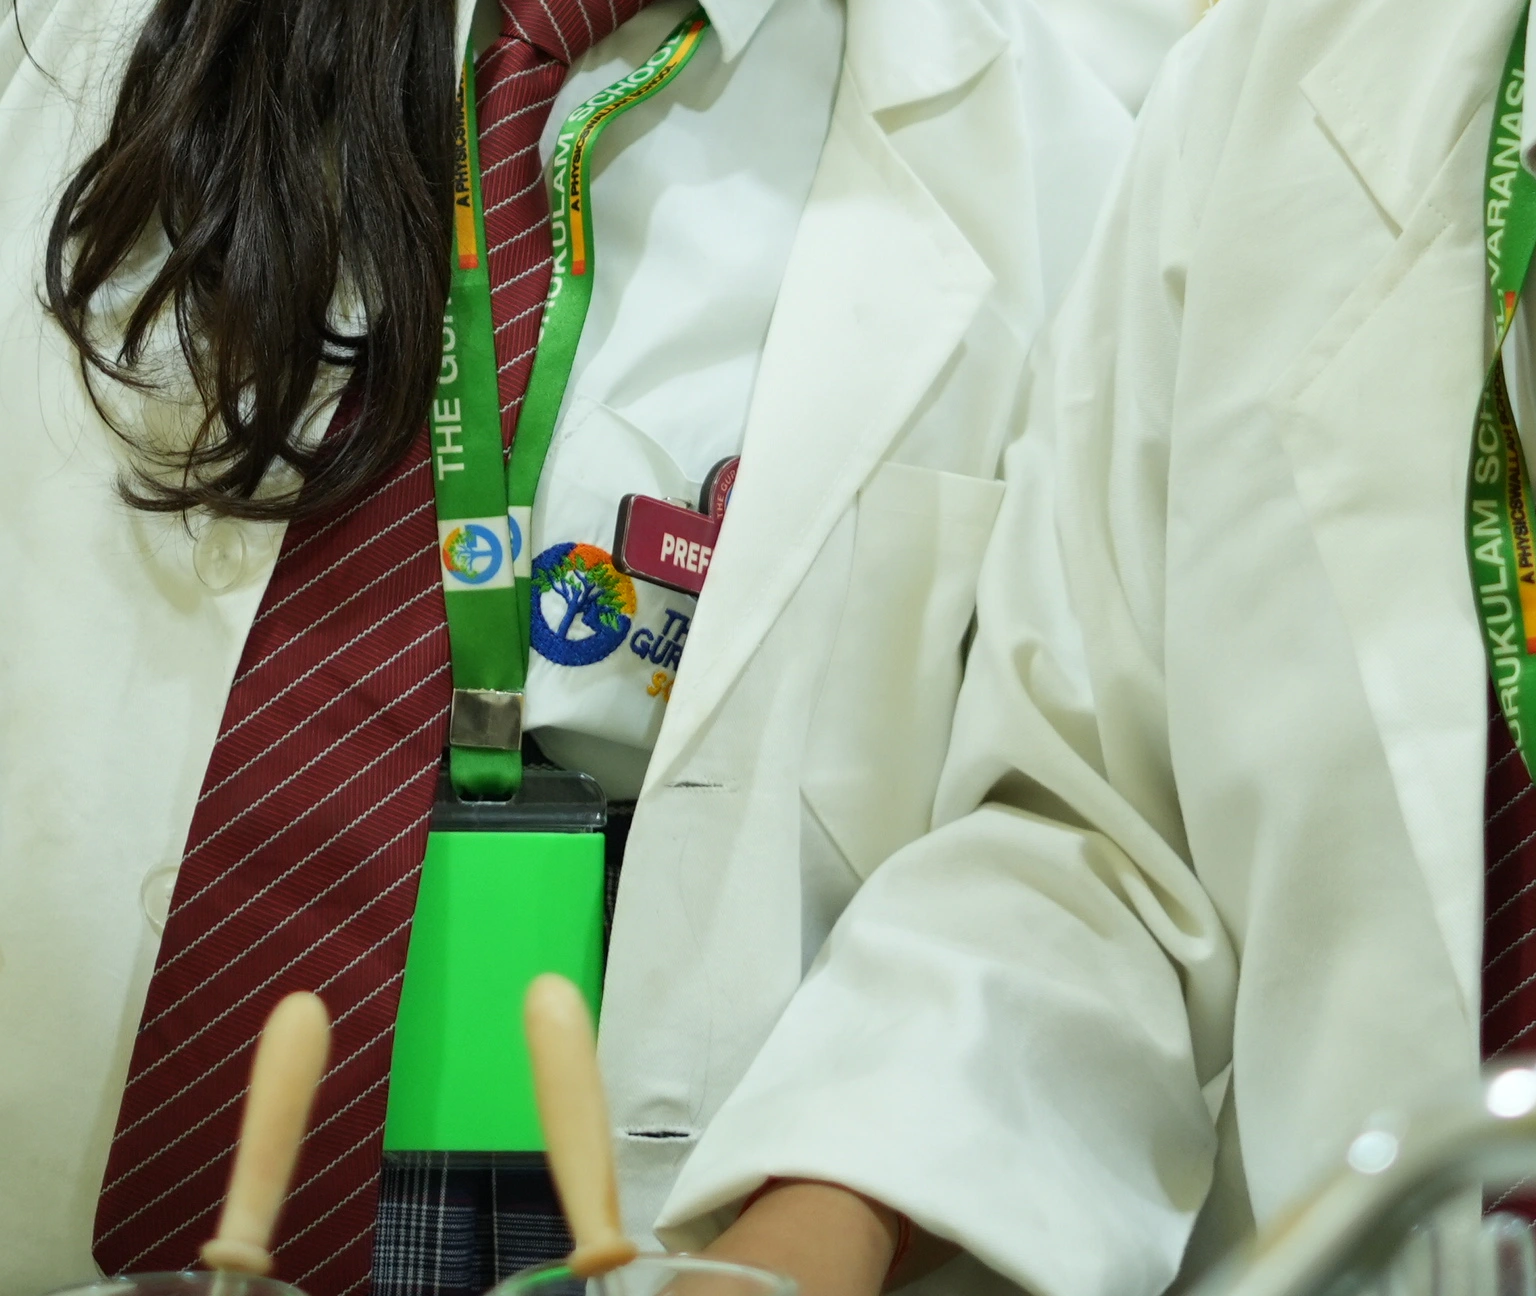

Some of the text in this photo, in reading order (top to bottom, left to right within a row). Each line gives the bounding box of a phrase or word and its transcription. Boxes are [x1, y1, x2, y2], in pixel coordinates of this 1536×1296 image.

[571, 199, 580, 212] A
[434, 398, 465, 481] THE
[660, 532, 714, 575] PREF
[1520, 570, 1536, 585] A
[629, 627, 684, 673] GUR
[1471, 499, 1532, 781] URUKULAM
